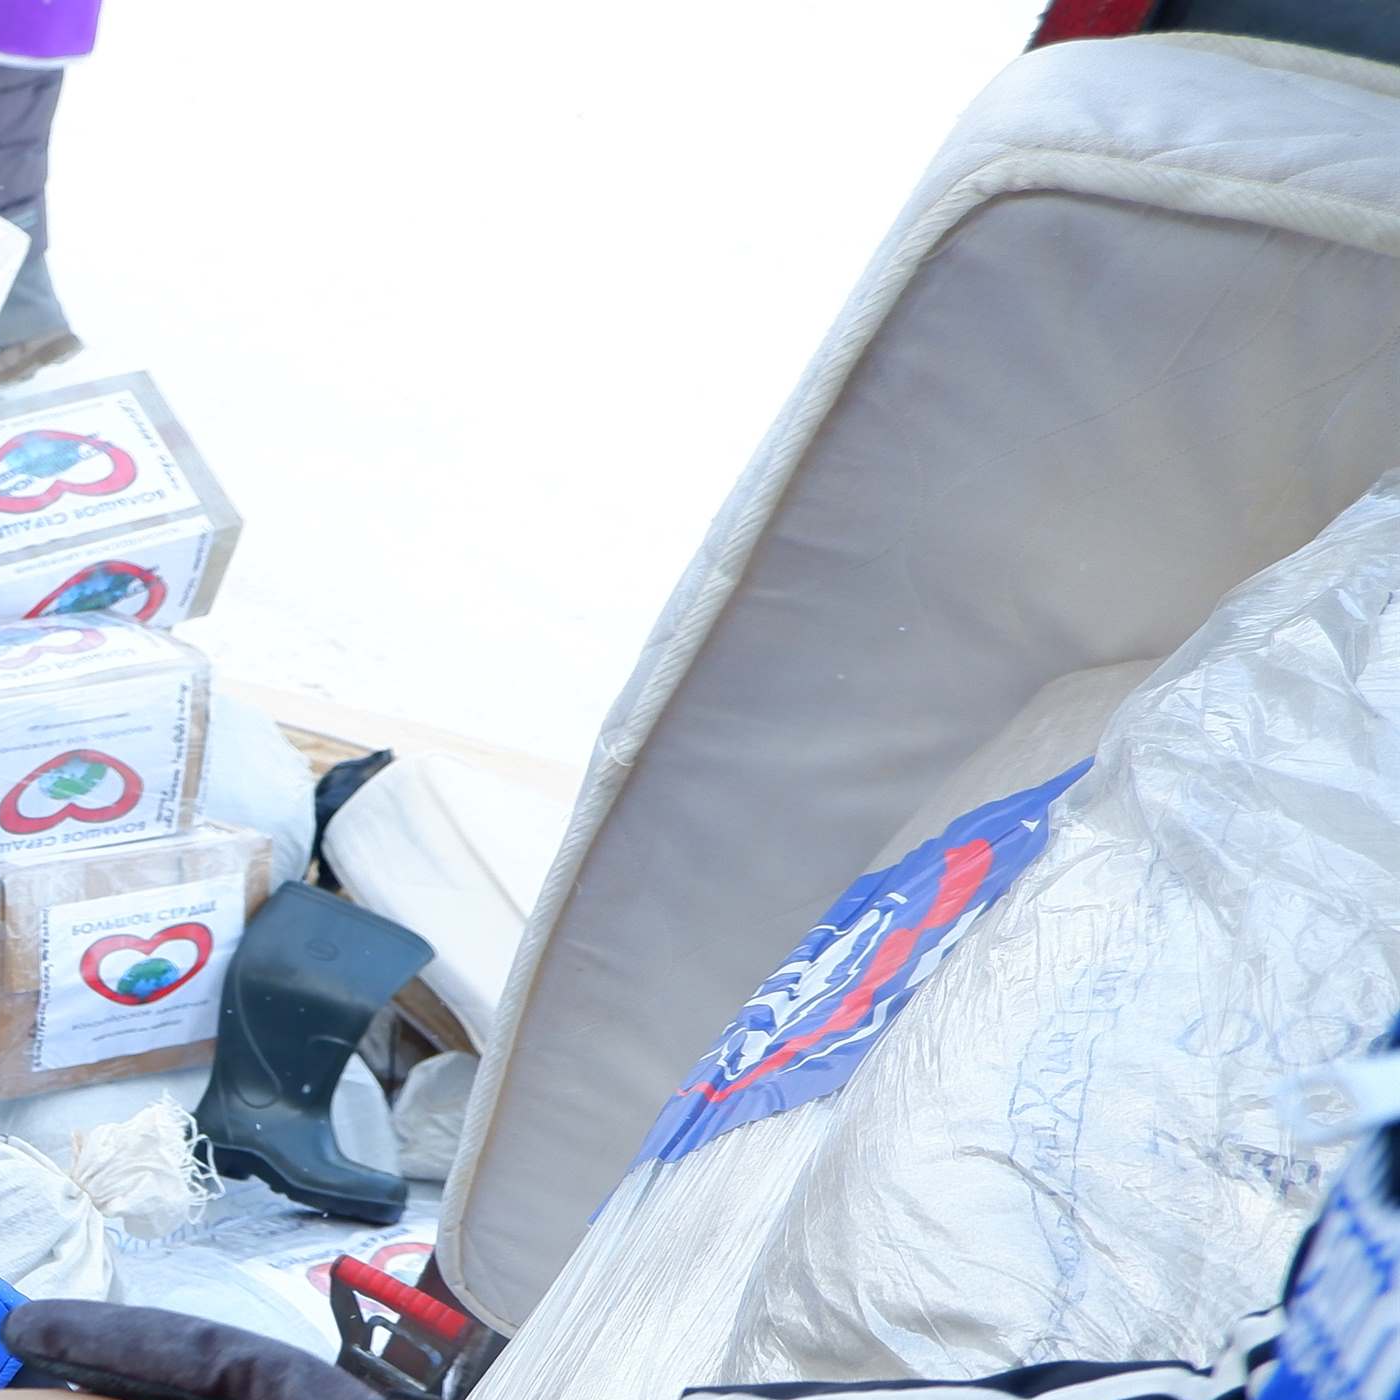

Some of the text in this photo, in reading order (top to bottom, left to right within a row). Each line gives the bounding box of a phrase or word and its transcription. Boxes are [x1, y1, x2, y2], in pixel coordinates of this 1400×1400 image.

[62, 821, 146, 845] БОЛЬШОЕ
[71, 899, 218, 936] БОЛЬШОЕ СЕРДЦЕ
